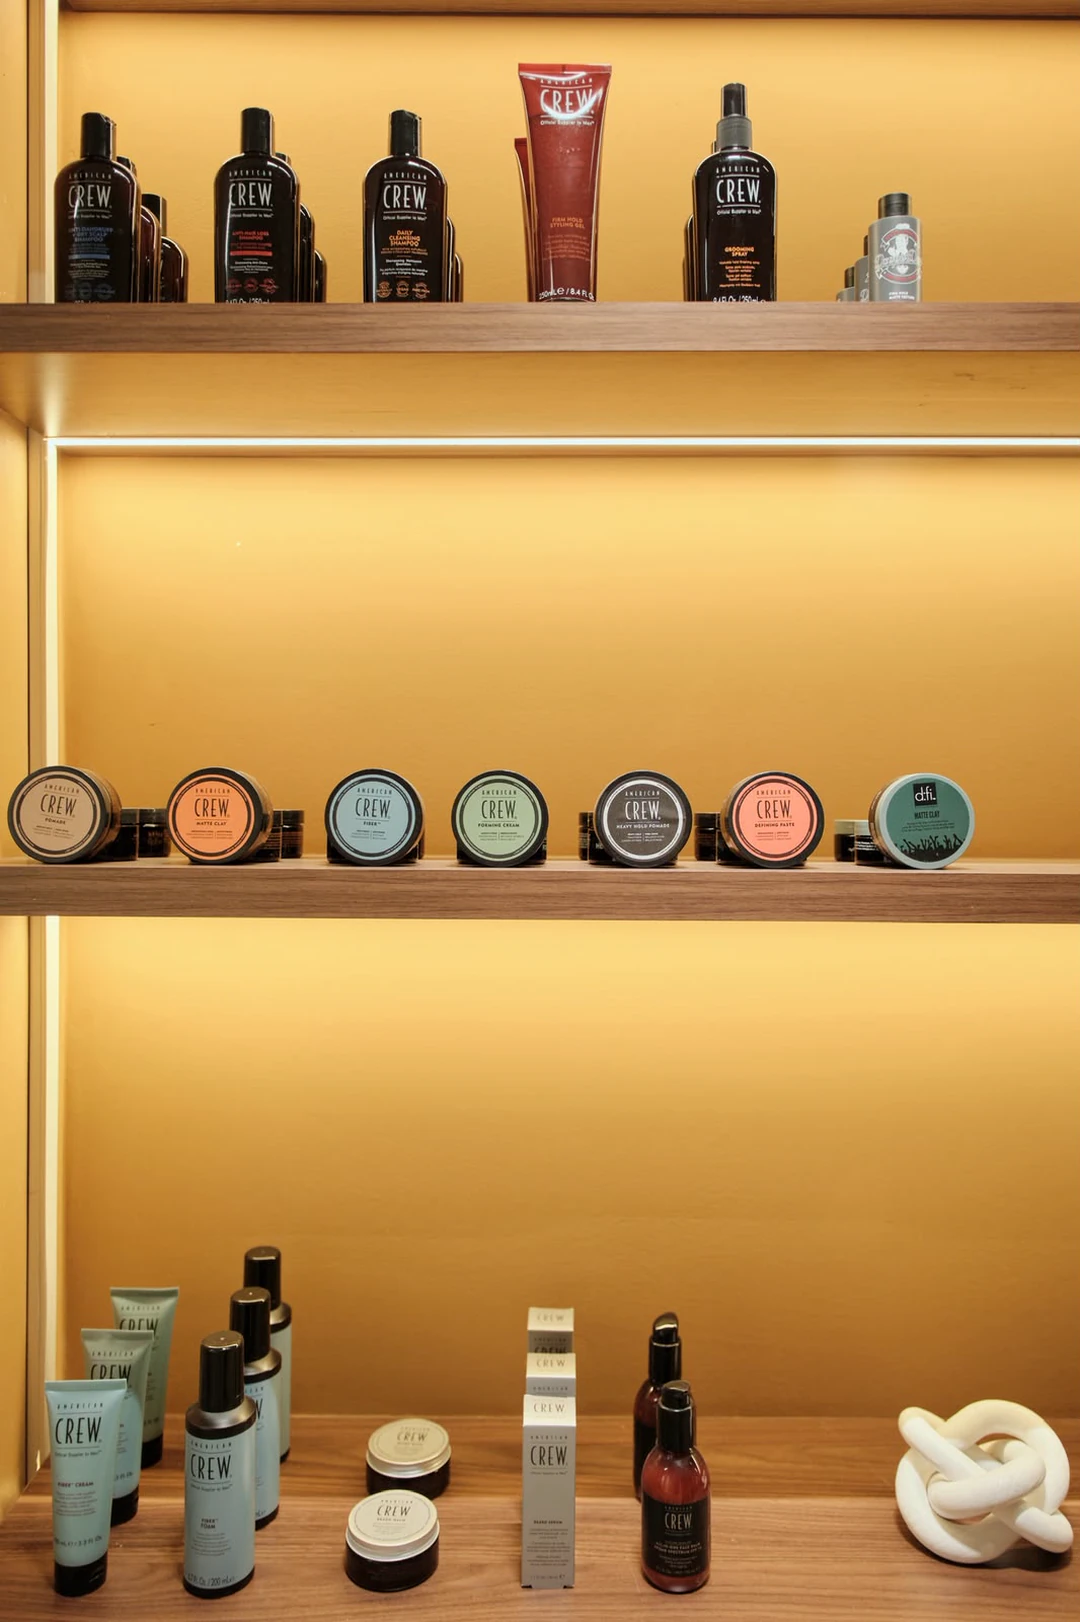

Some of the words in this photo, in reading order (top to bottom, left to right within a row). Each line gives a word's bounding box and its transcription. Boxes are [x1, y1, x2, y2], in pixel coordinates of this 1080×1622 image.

[44, 783, 80, 794] AMERICAN
[357, 787, 393, 795] AMERICAN
[914, 811, 928, 820] MATTE
[928, 810, 940, 818] CLAY
[45, 817, 66, 825] POMADE
